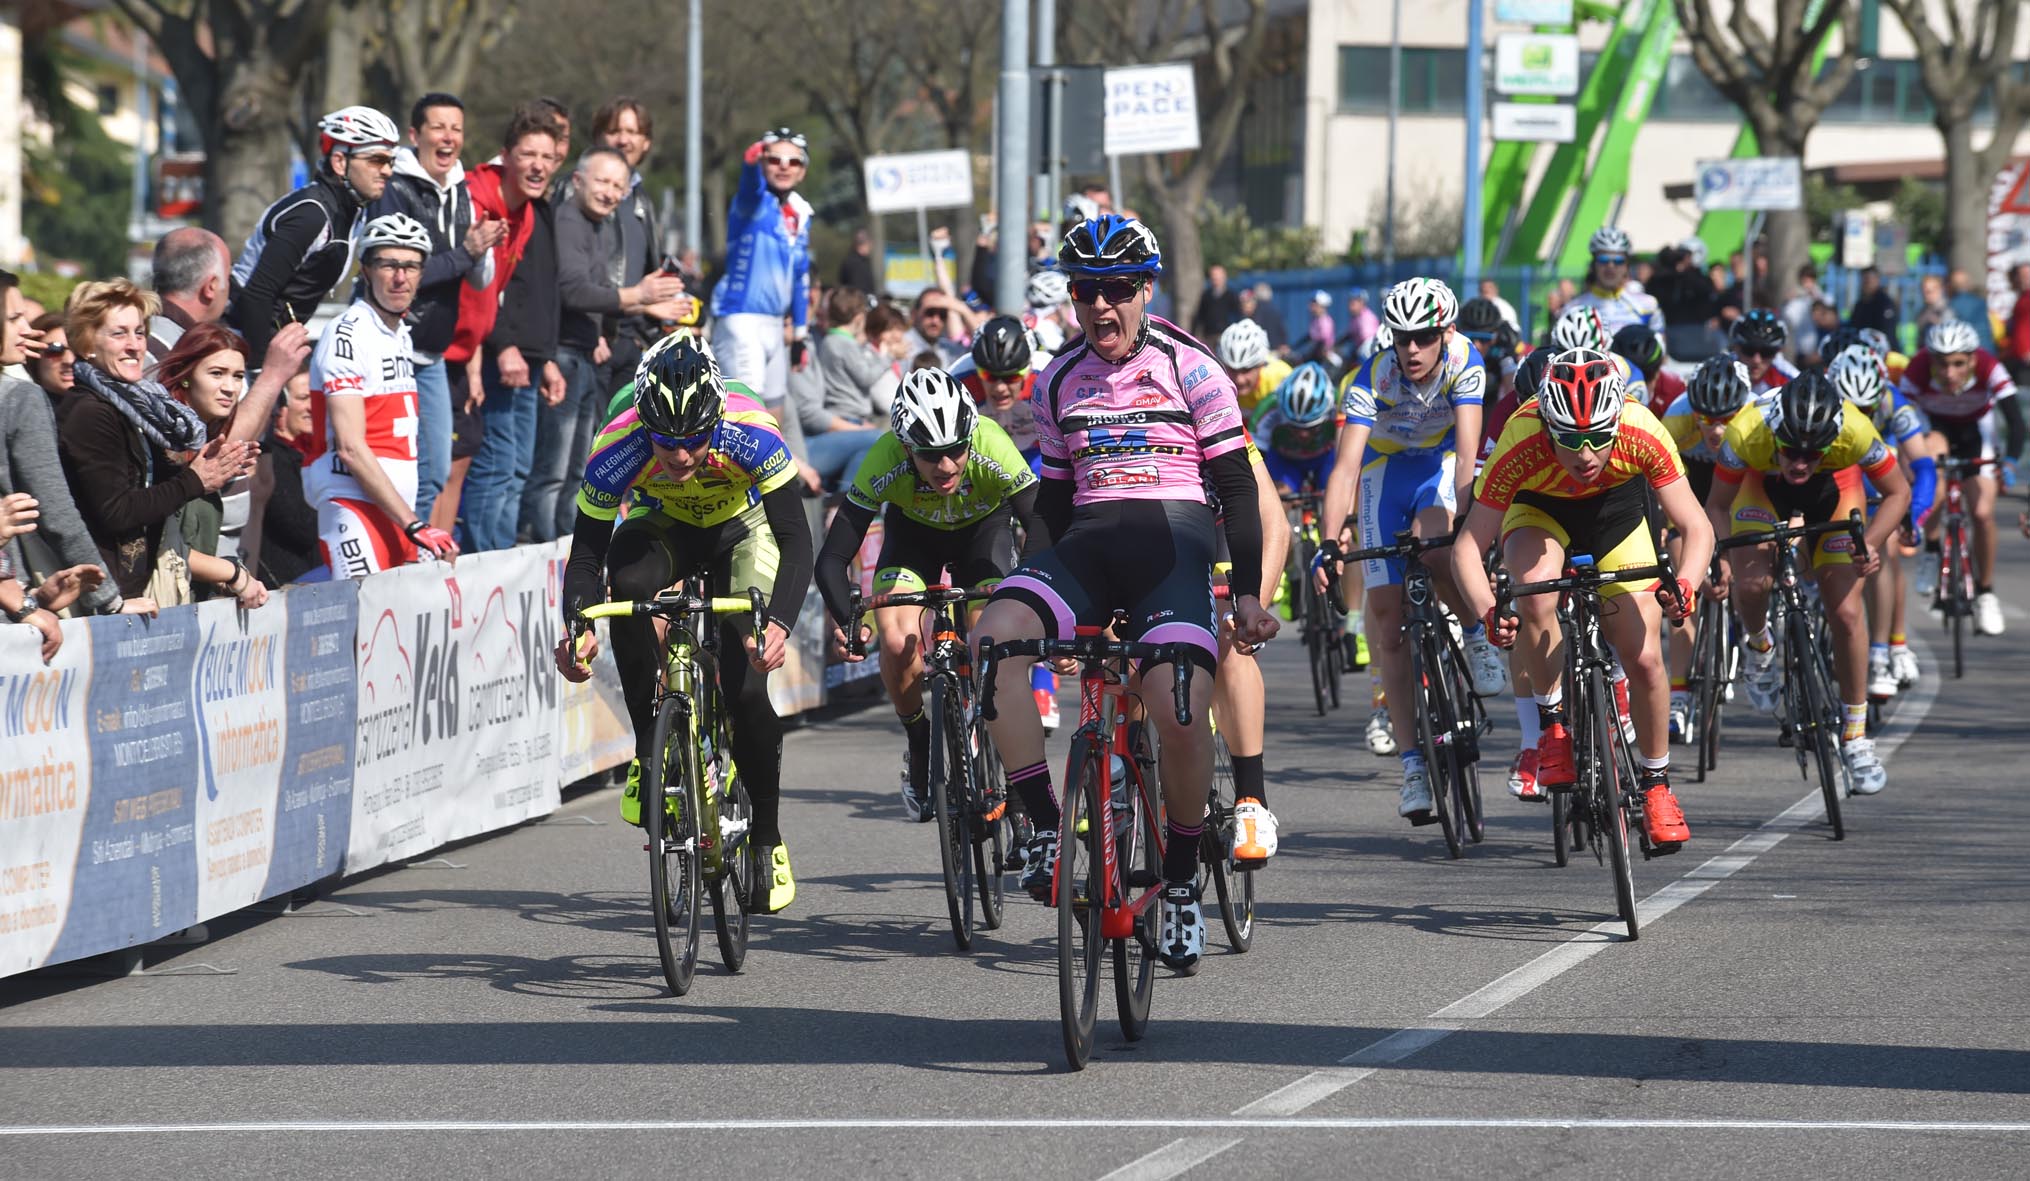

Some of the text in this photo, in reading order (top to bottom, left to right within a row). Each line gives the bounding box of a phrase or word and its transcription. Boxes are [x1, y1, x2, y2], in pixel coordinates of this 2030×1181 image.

[340, 538, 371, 576] BM
[1365, 528, 1381, 574] impnti
[205, 640, 237, 703] BLUE
[236, 633, 278, 697] MOON
[5, 667, 77, 737] MOON
[214, 707, 279, 777] informatica
[1167, 887, 1191, 898] SIDI
